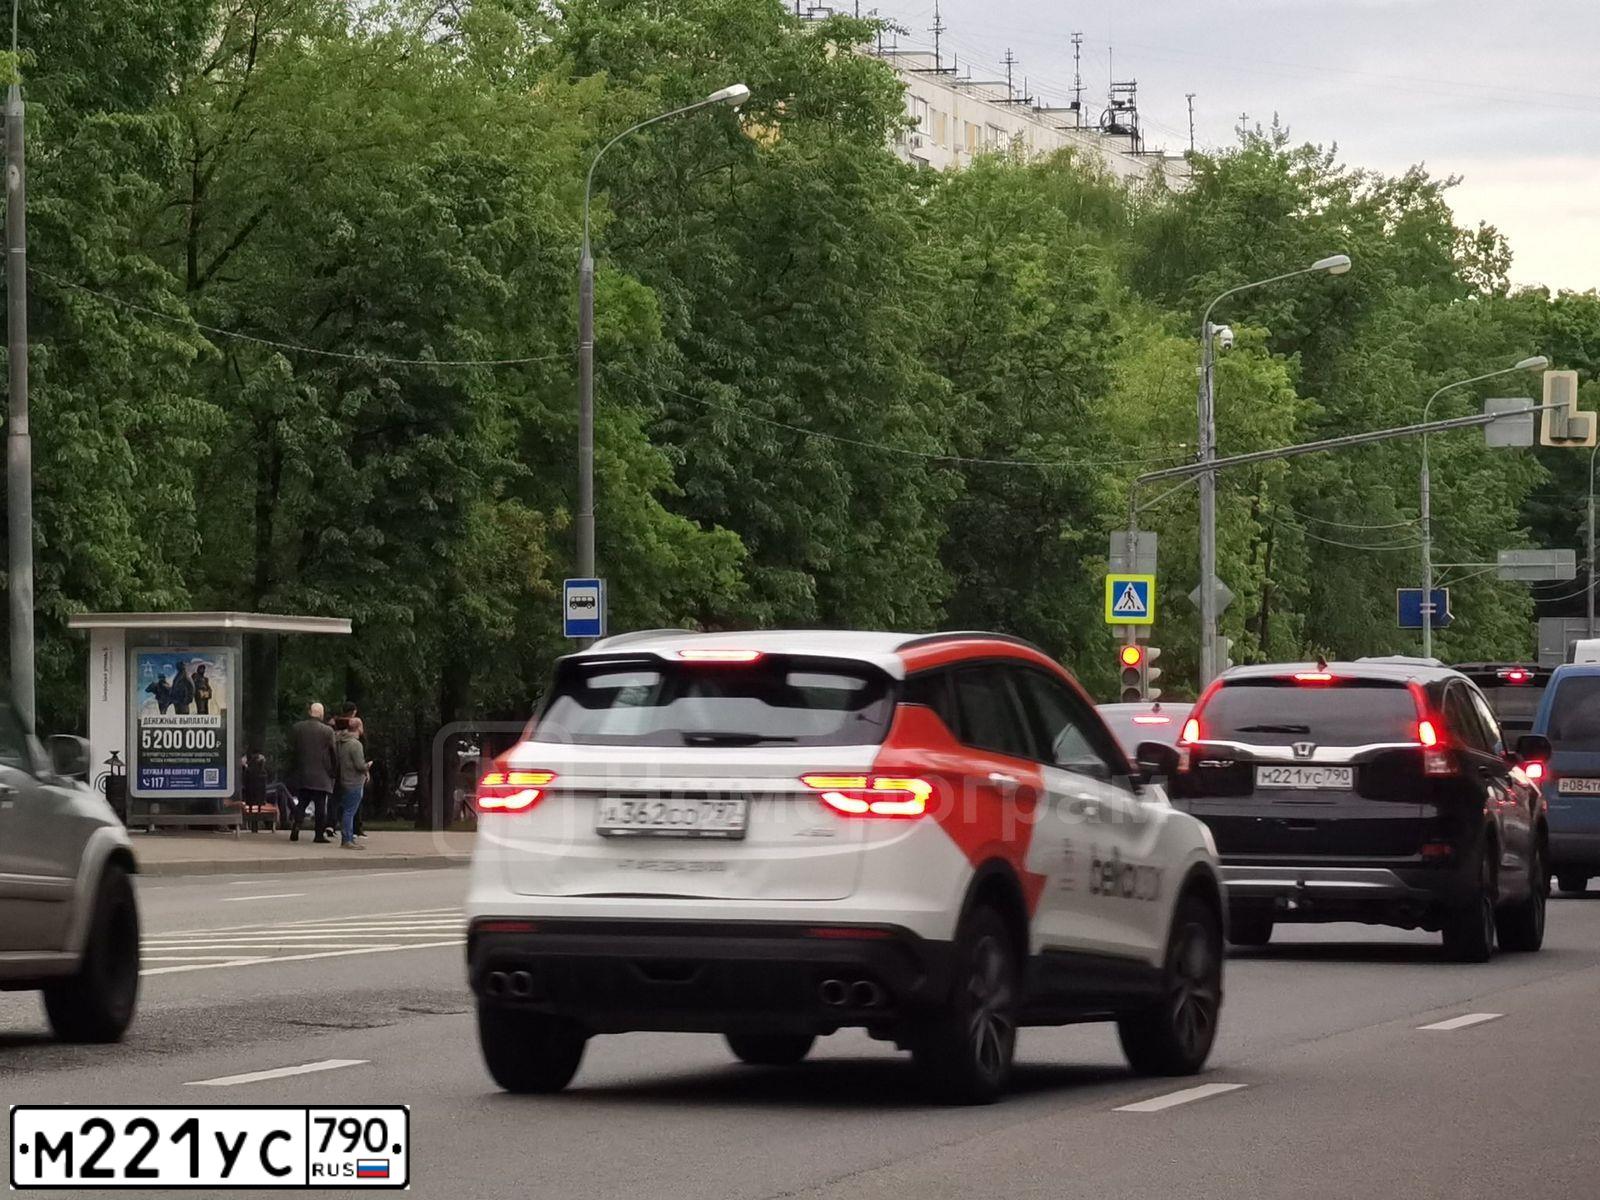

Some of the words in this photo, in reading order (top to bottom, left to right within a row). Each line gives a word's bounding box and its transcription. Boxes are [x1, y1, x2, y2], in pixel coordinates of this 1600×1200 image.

[143, 717, 177, 725] ДЕНЕЖНЫЕ
[179, 717, 209, 725] ВЫПЛАТЫ
[151, 777, 164, 788] 117
